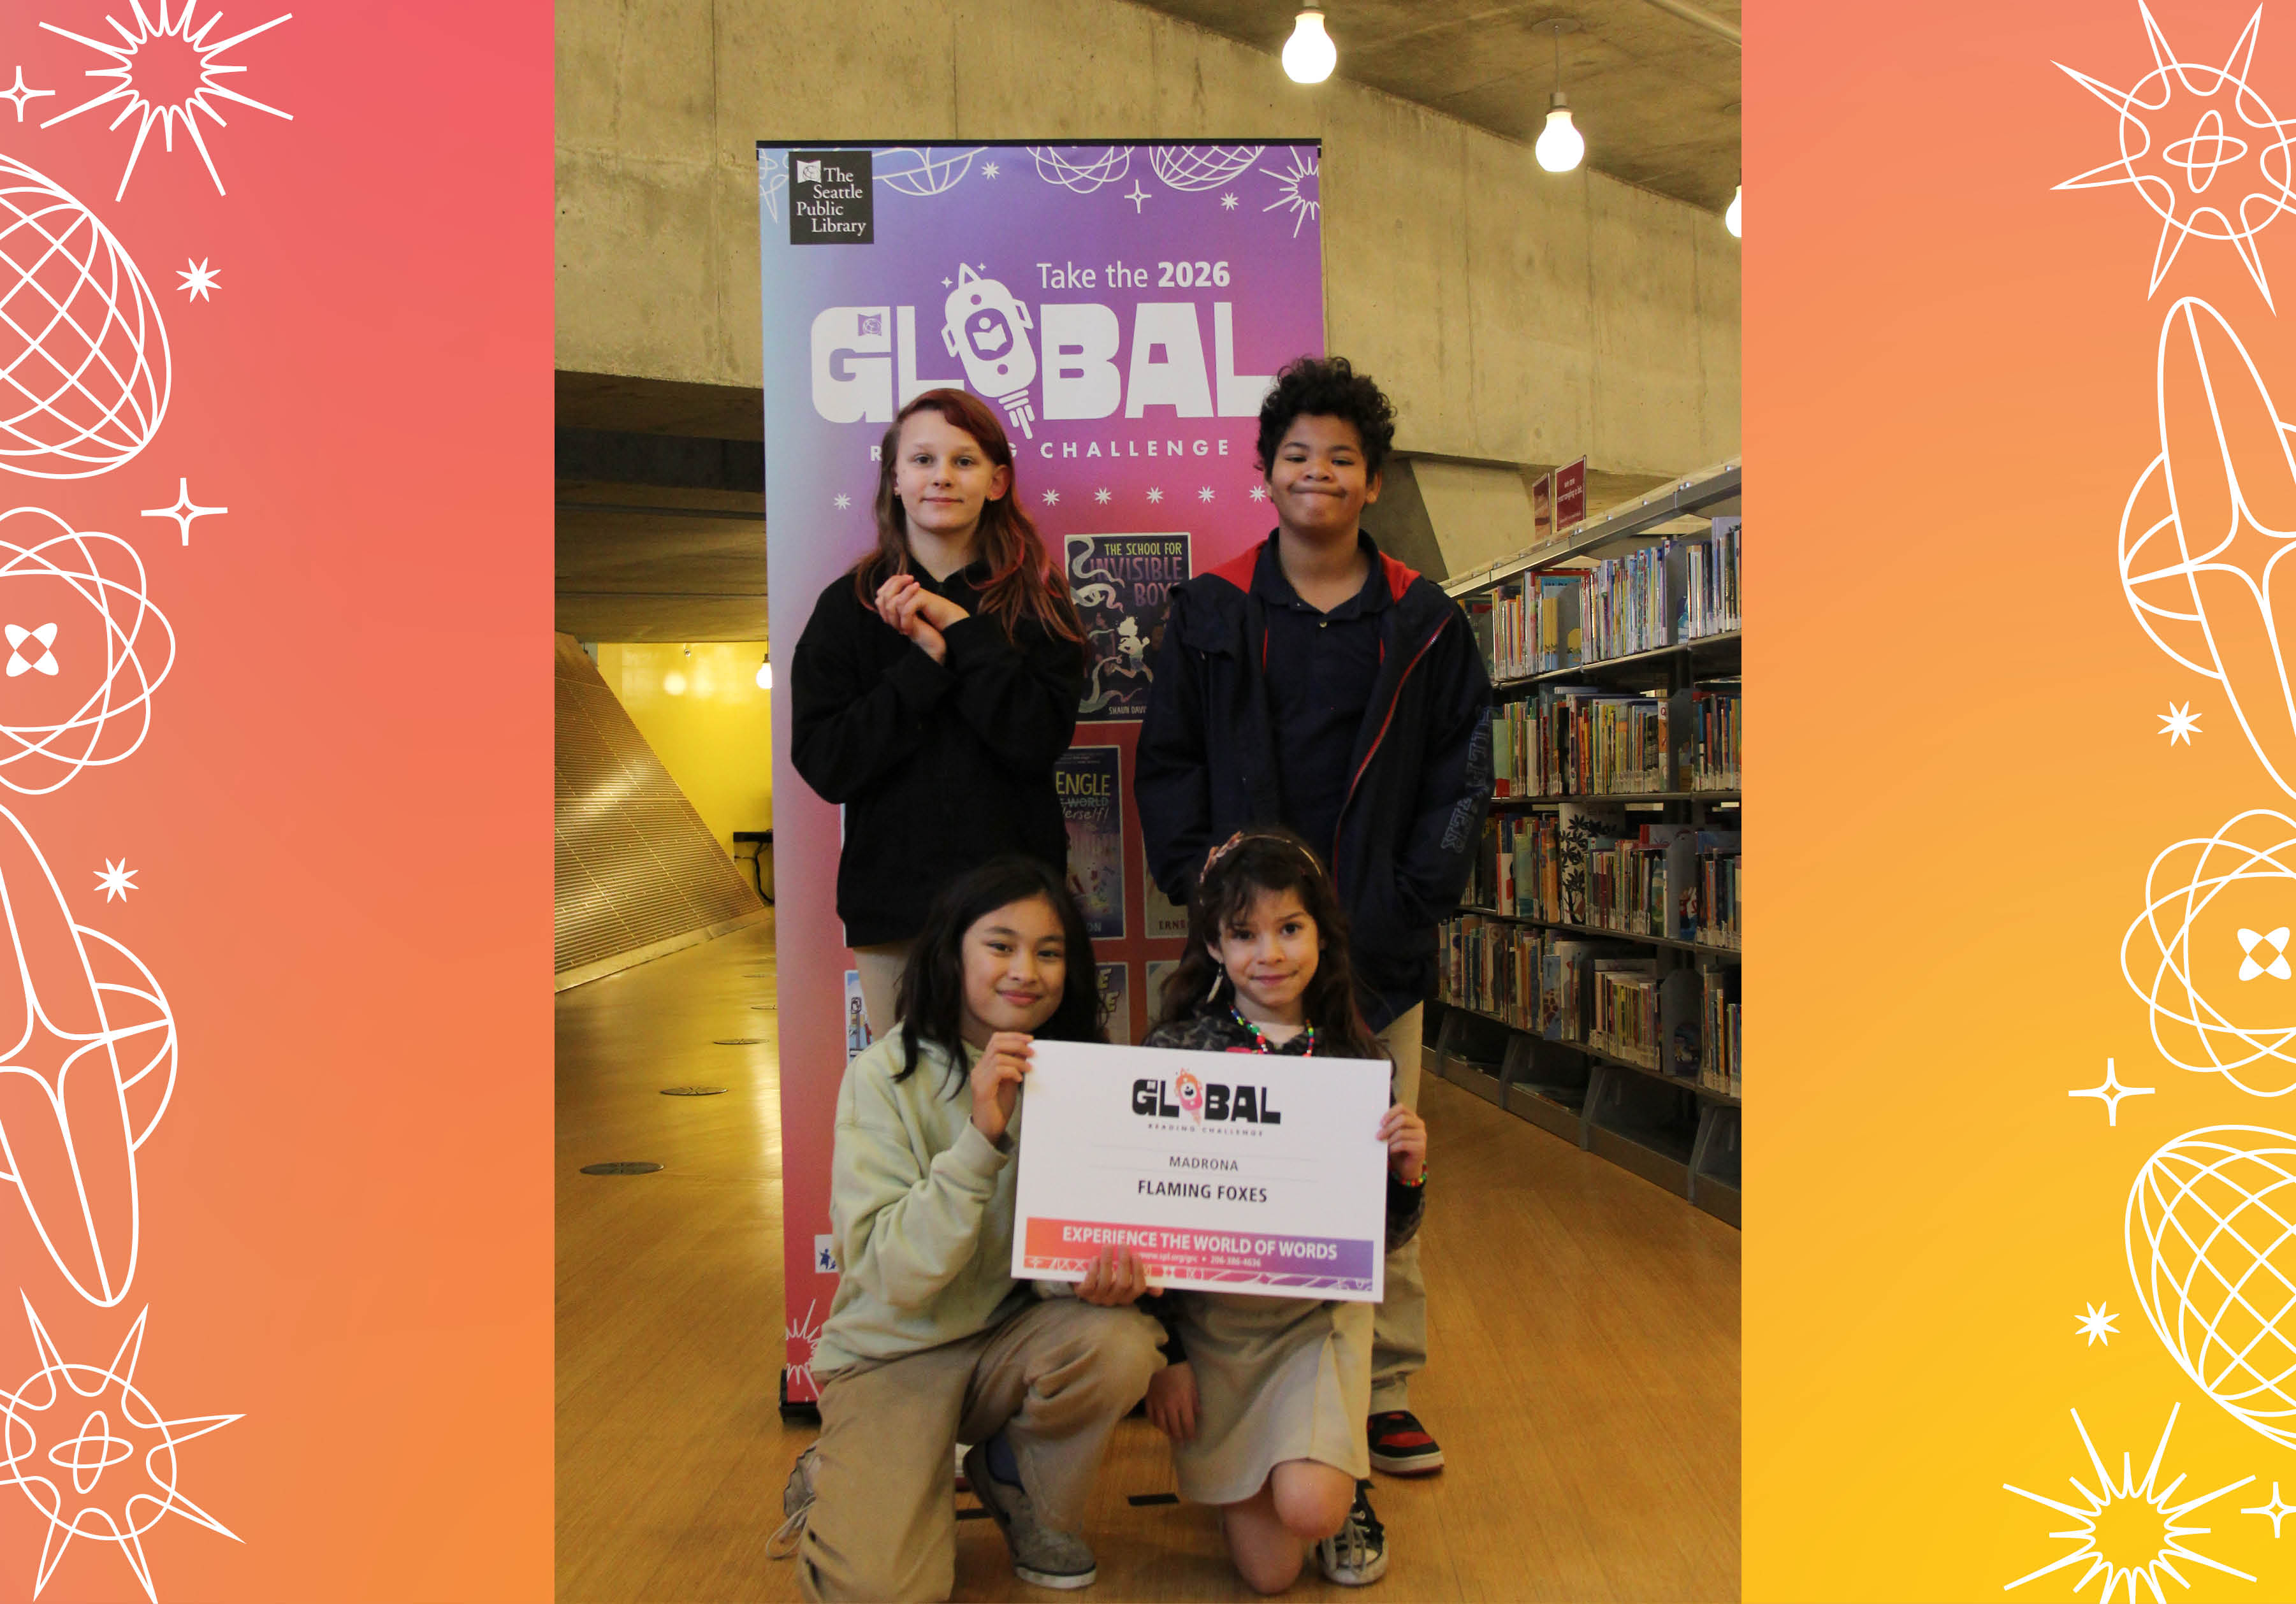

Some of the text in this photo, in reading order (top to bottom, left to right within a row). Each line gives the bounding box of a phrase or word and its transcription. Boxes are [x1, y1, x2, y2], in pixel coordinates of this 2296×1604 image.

[824, 167, 854, 182] The
[813, 184, 862, 199] Seattle
[796, 201, 844, 216] Public
[811, 218, 866, 236] Library
[1036, 261, 1231, 289] Take the 2026
[811, 302, 1277, 423] GLOBAL
[1040, 439, 1230, 459] CHALLENGE
[1104, 542, 1182, 555] THE SCHOOL FOR
[1089, 556, 1183, 581] INVISIBLE
[1134, 582, 1179, 607] BOY
[1132, 1077, 1281, 1124] GLOBAL
[1169, 1155, 1239, 1171] MADRONA
[1138, 1180, 1267, 1203] FLAMING FOXES
[1063, 1225, 1338, 1261] EXPERIENCE THE WORLD OF WORDS
